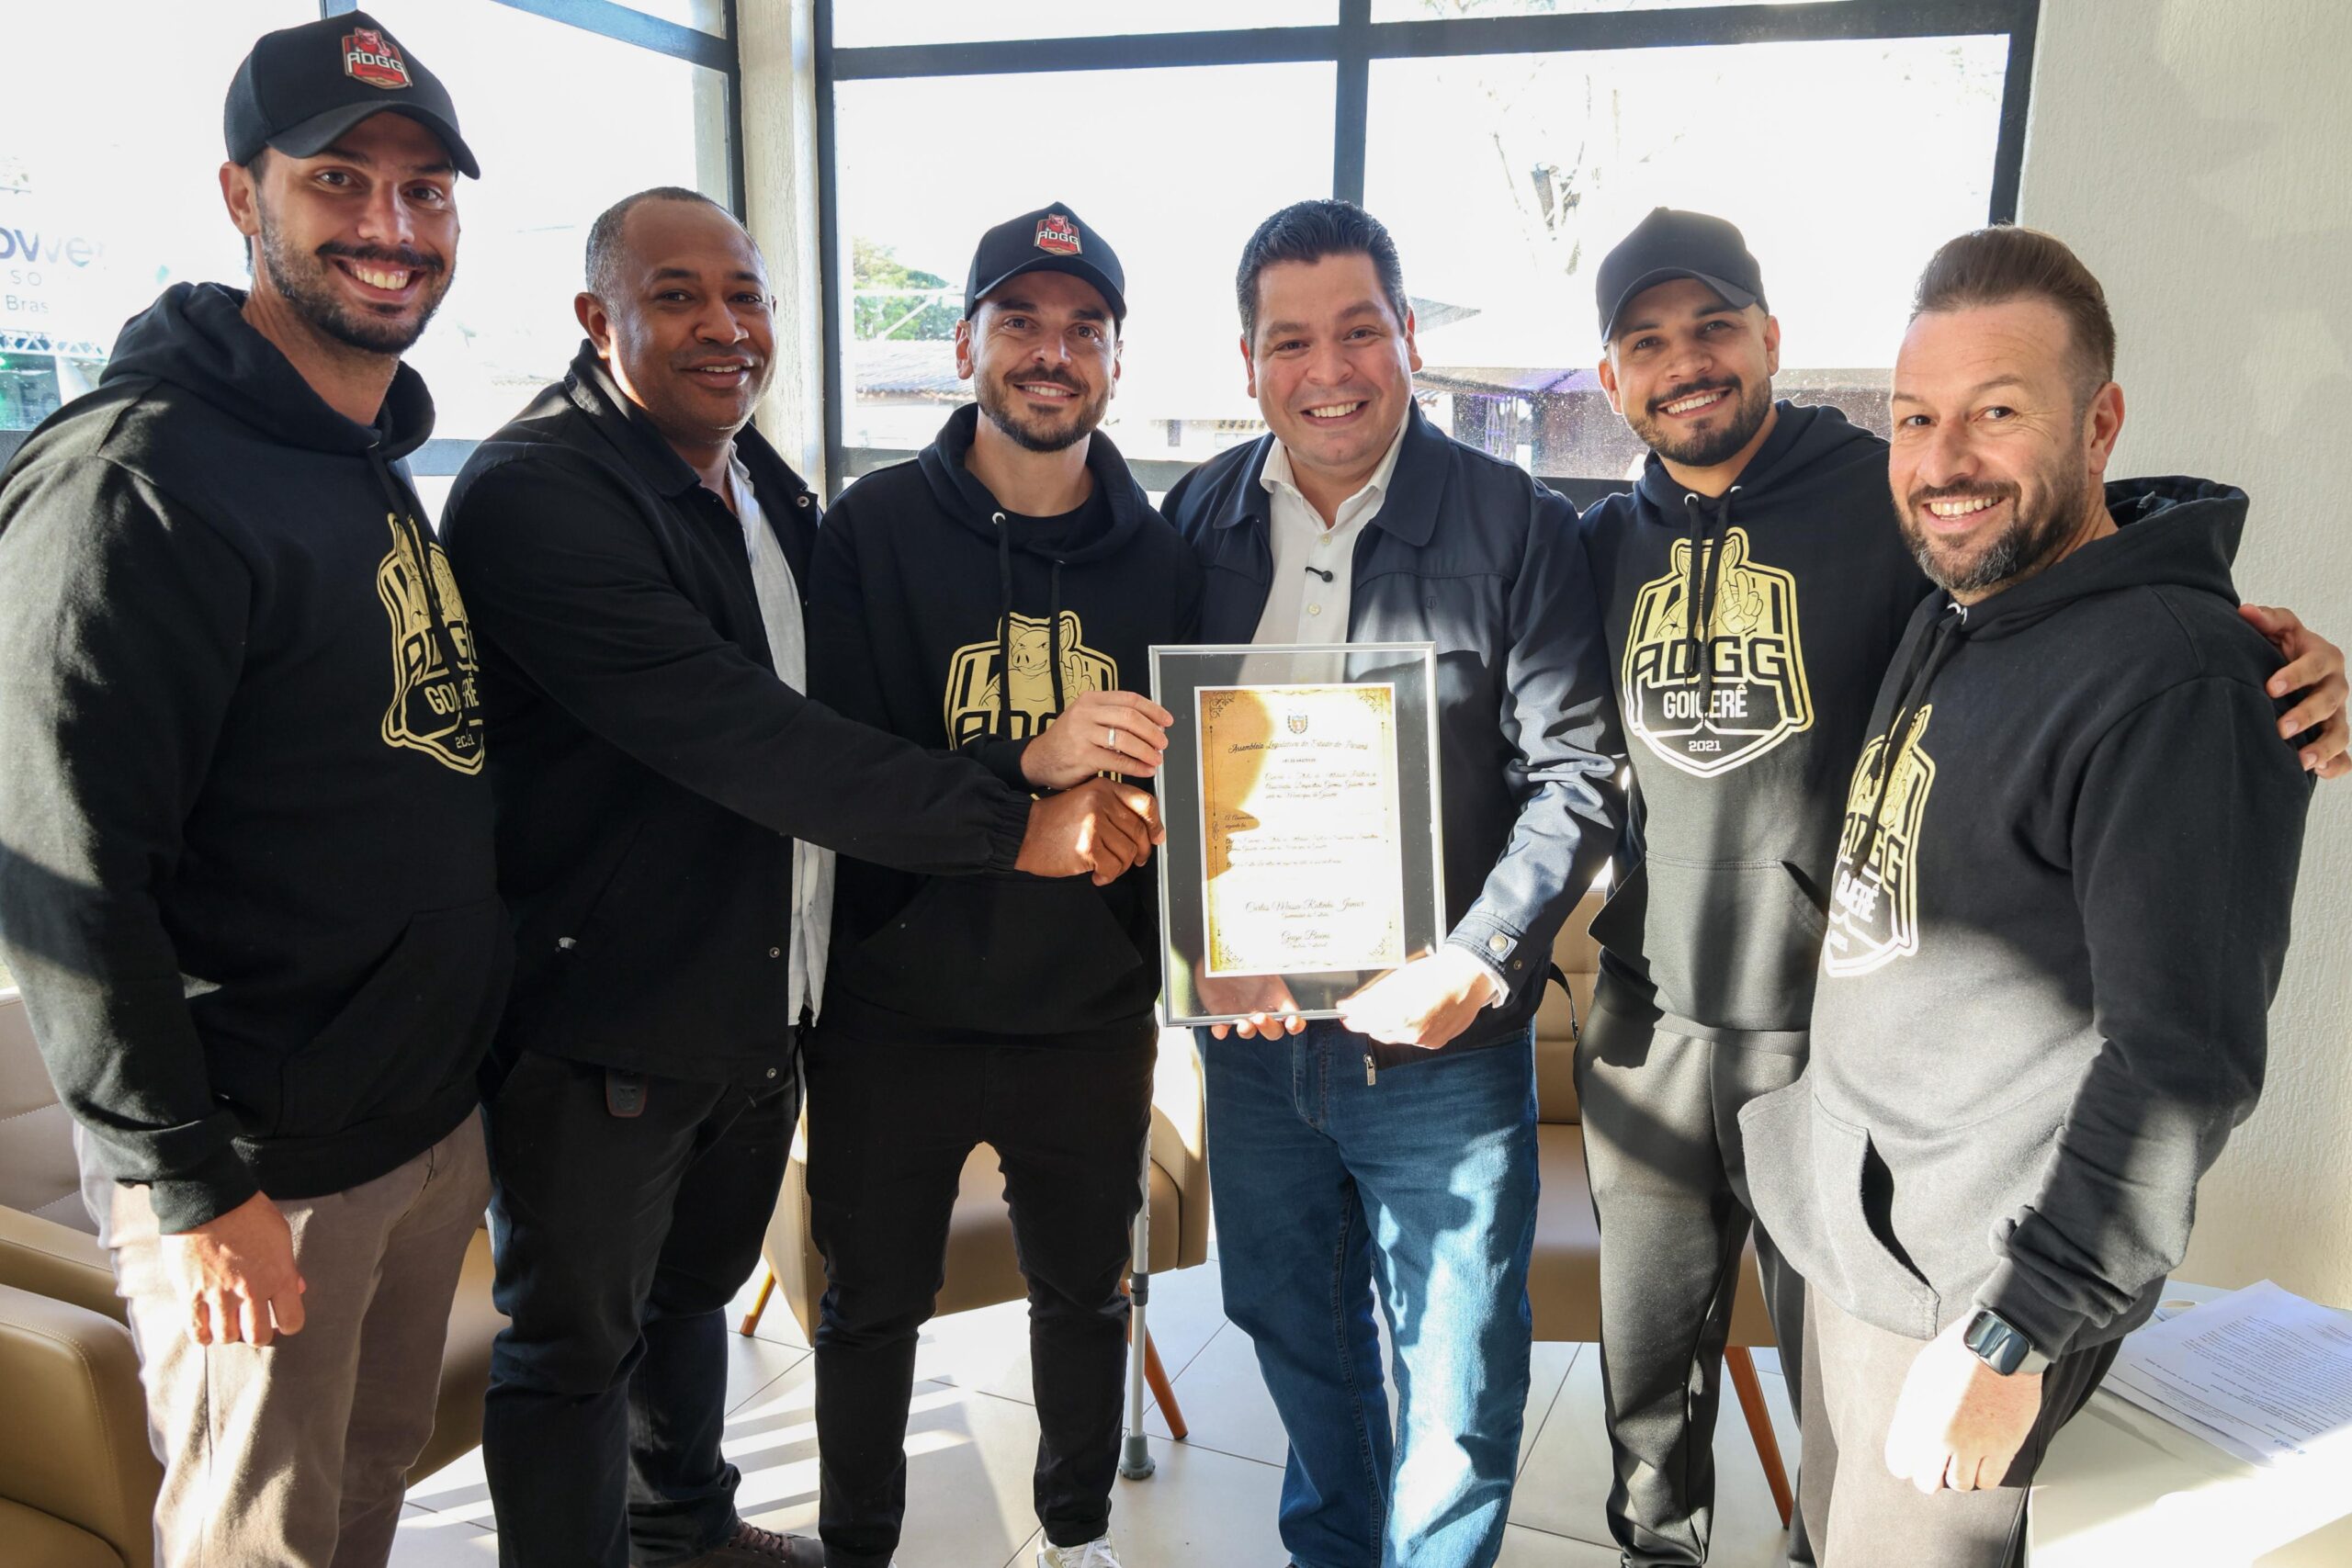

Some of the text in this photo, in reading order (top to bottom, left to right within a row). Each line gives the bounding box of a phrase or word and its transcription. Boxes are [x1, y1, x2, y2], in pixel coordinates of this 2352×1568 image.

[346, 51, 410, 83] ADGG
[1036, 231, 1080, 252] ADGG
[1688, 739, 1722, 752] 2021
